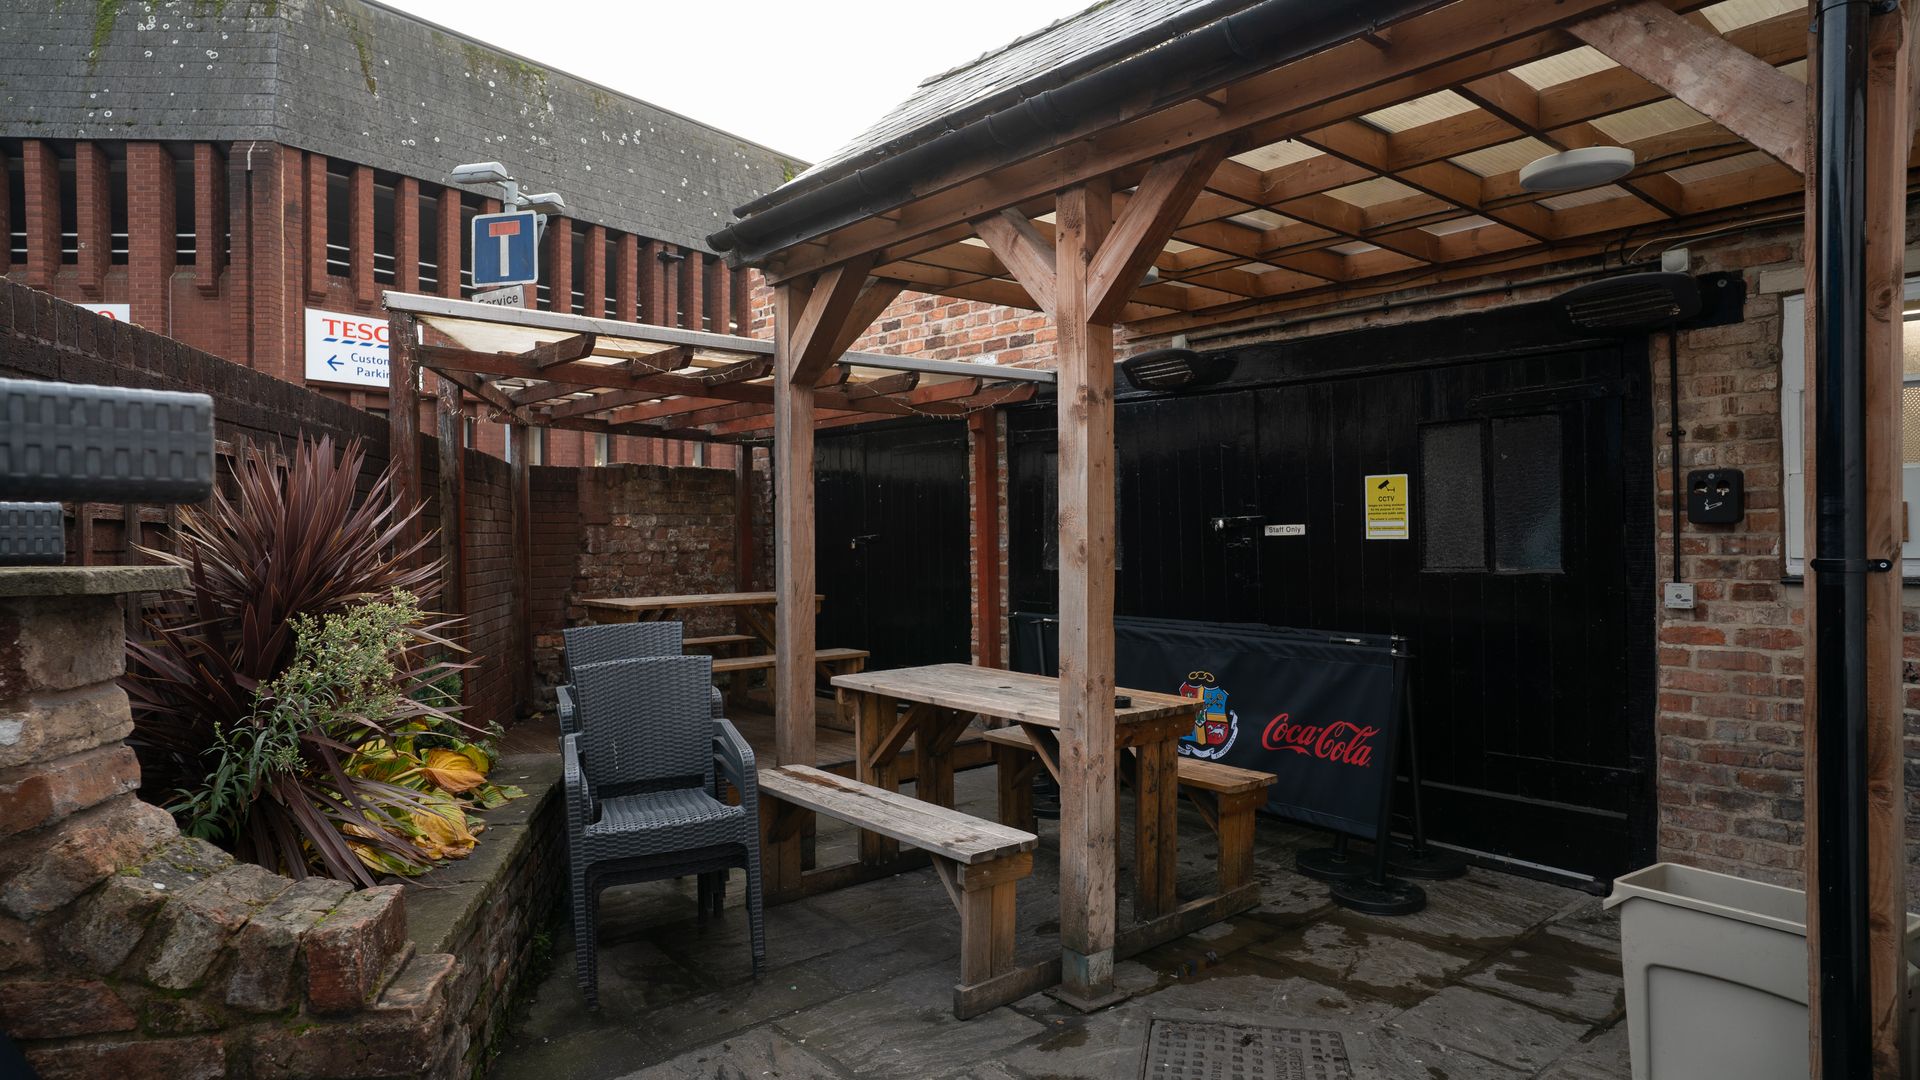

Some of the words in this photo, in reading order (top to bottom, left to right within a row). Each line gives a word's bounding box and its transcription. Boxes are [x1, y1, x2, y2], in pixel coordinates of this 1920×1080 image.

[322, 318, 390, 343] TESC
[1268, 526, 1284, 534] Staff
[1285, 526, 1302, 534] Only
[1262, 713, 1380, 767] Coca-Cola
